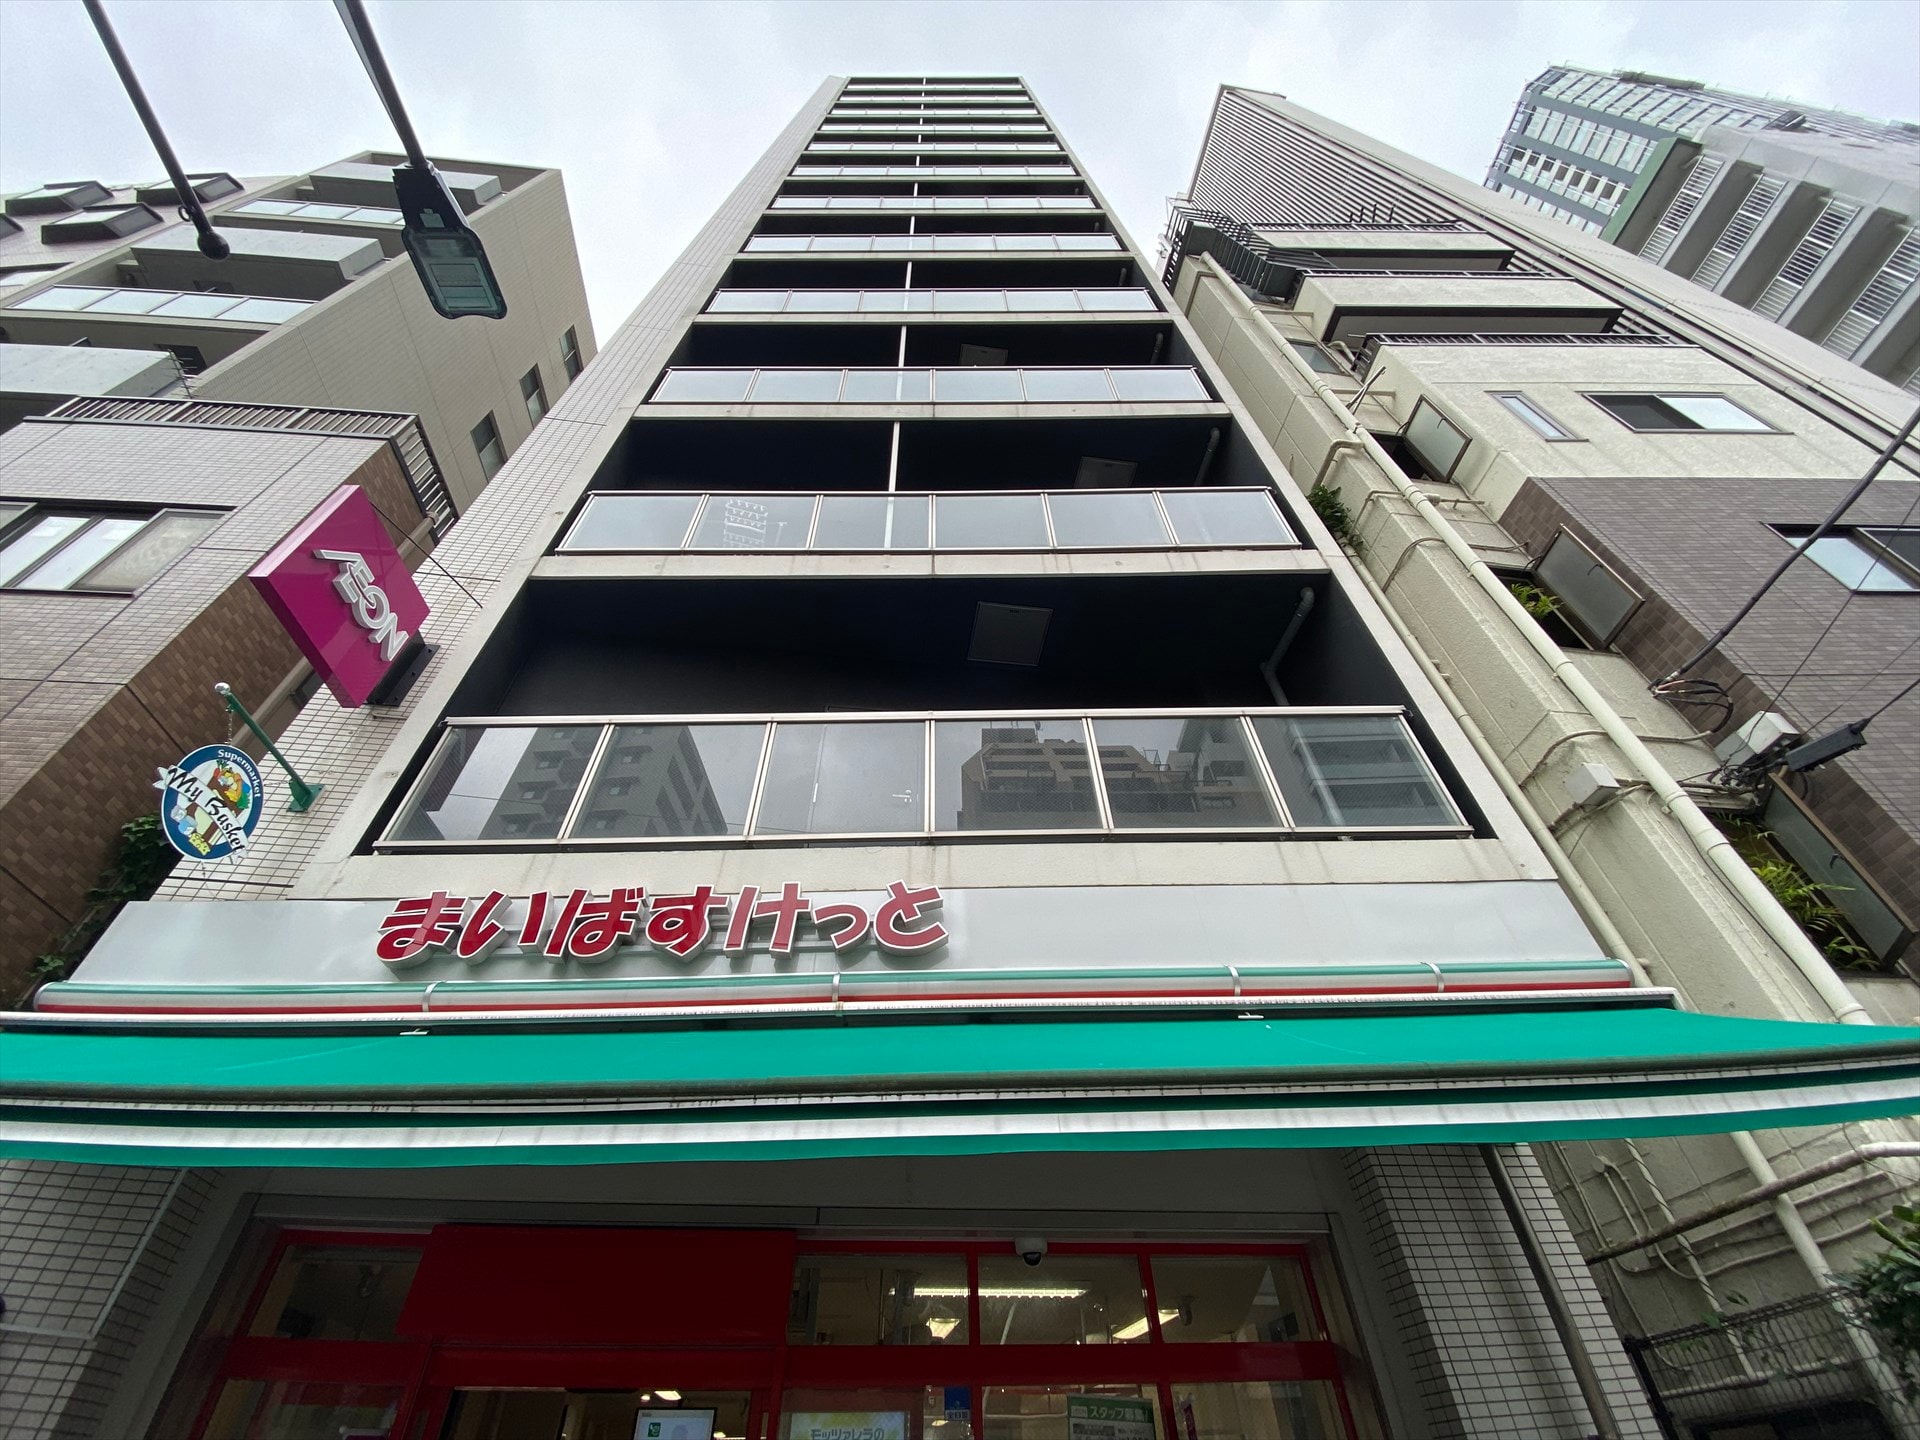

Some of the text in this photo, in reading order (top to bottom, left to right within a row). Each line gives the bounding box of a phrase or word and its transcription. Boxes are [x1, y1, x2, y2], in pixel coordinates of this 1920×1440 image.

[315, 549, 409, 661] AEON
[168, 767, 245, 852] My Basket
[217, 749, 261, 798] Supermarket
[376, 880, 949, 964] まいばすけっと
[810, 1427, 886, 1440] モッツァレラの
